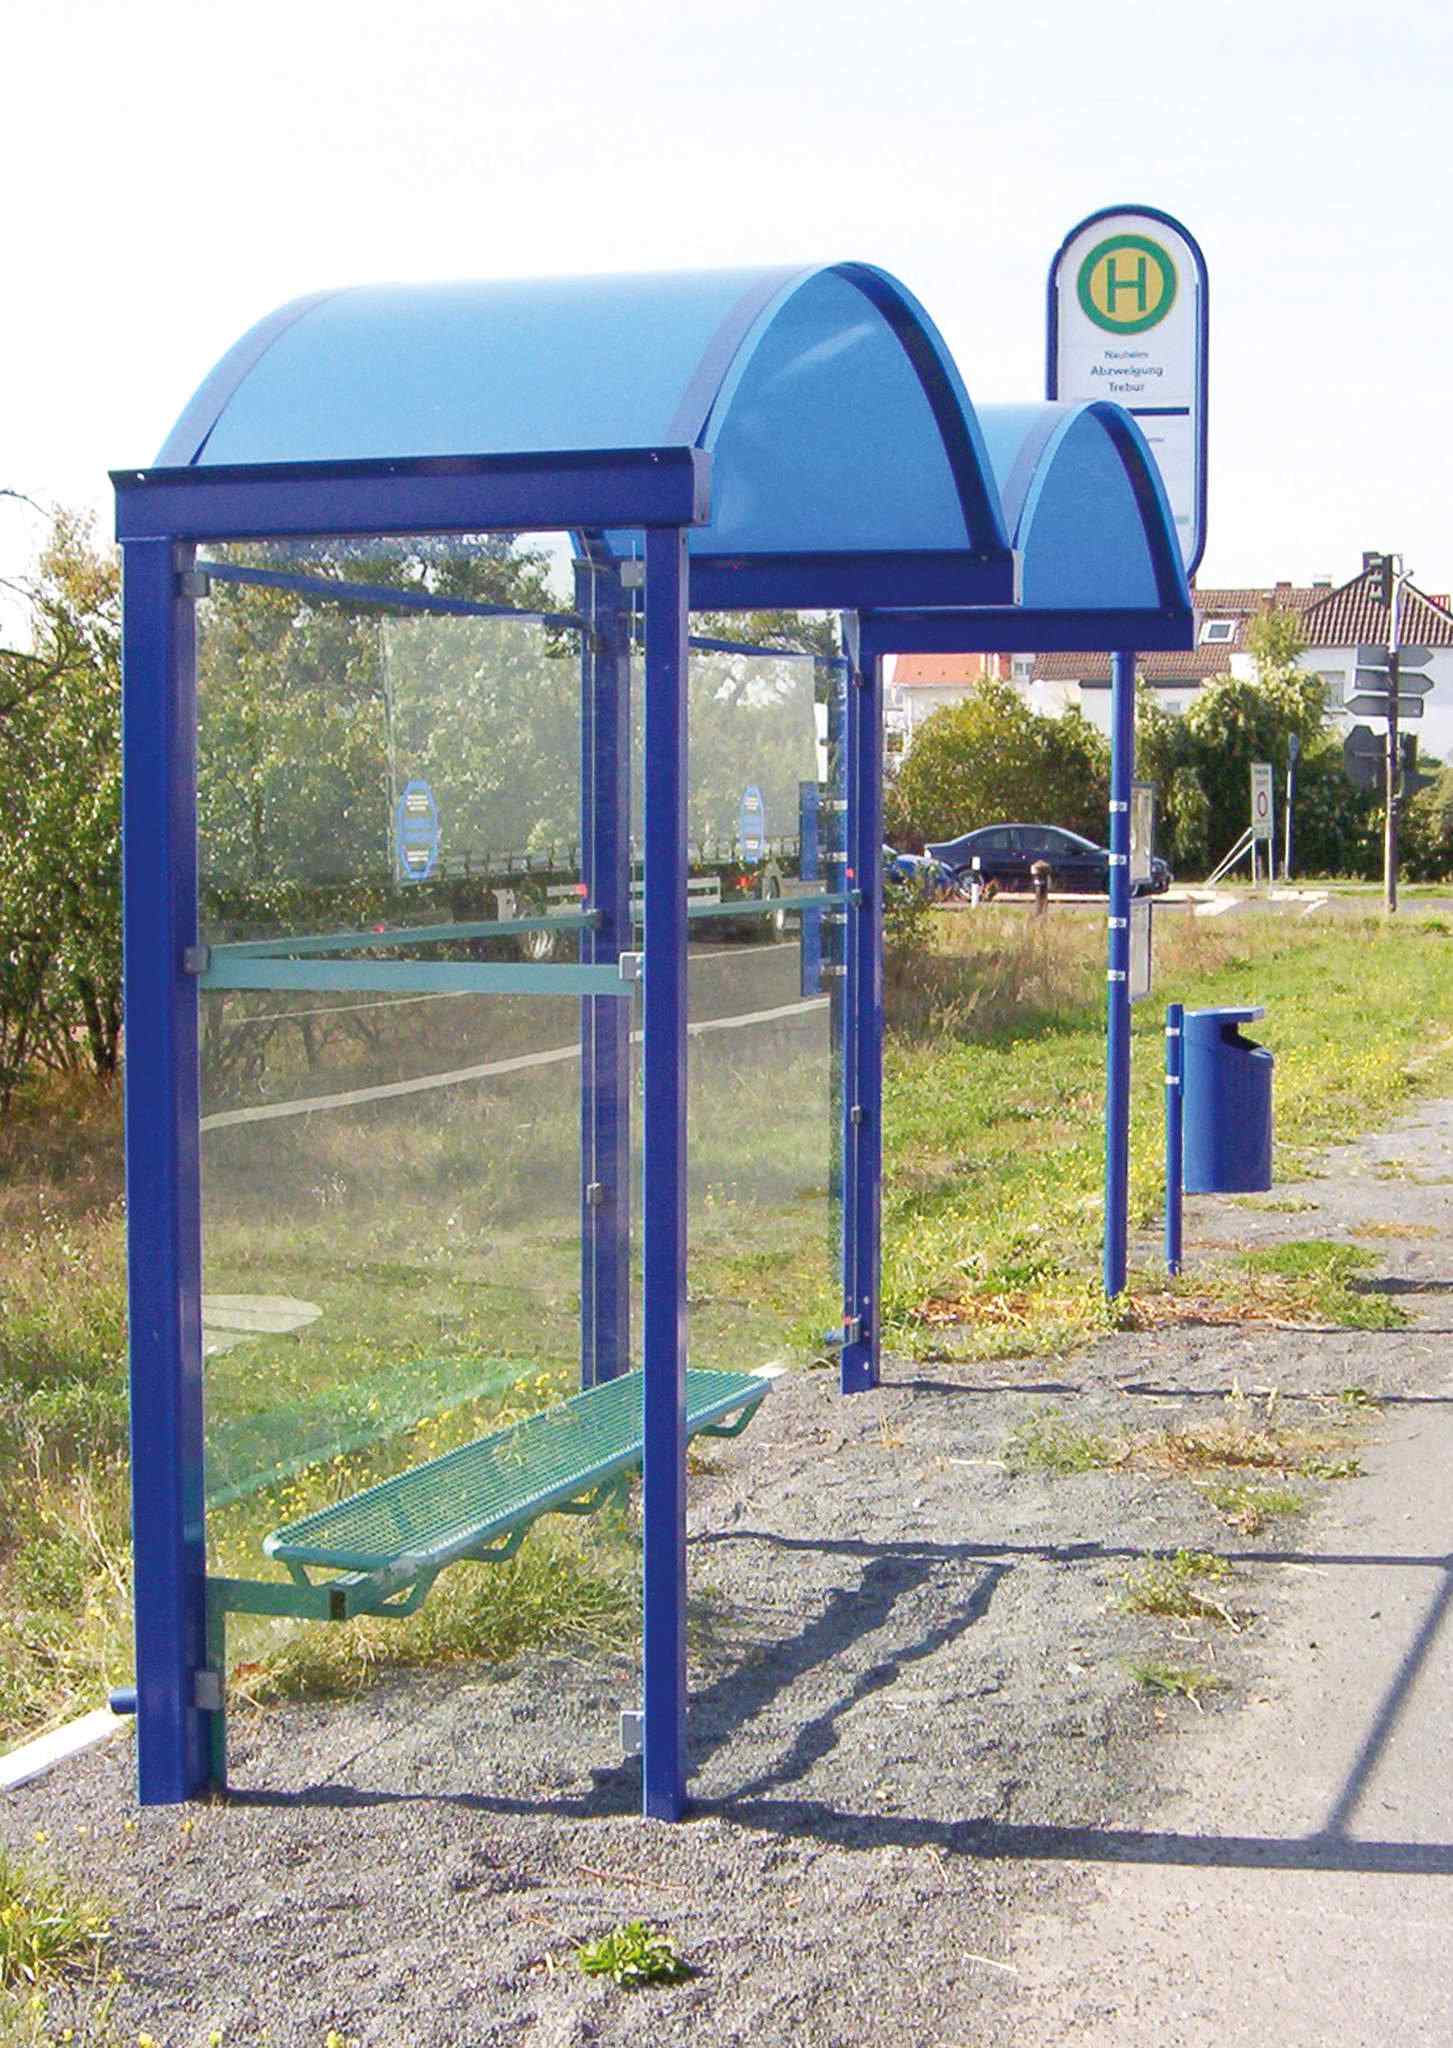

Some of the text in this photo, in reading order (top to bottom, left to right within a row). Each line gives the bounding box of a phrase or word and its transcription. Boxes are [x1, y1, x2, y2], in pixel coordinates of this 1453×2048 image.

[1107, 257, 1146, 312] H
[1090, 364, 1164, 377] Abzweigung
[1108, 381, 1145, 392] Trebur
